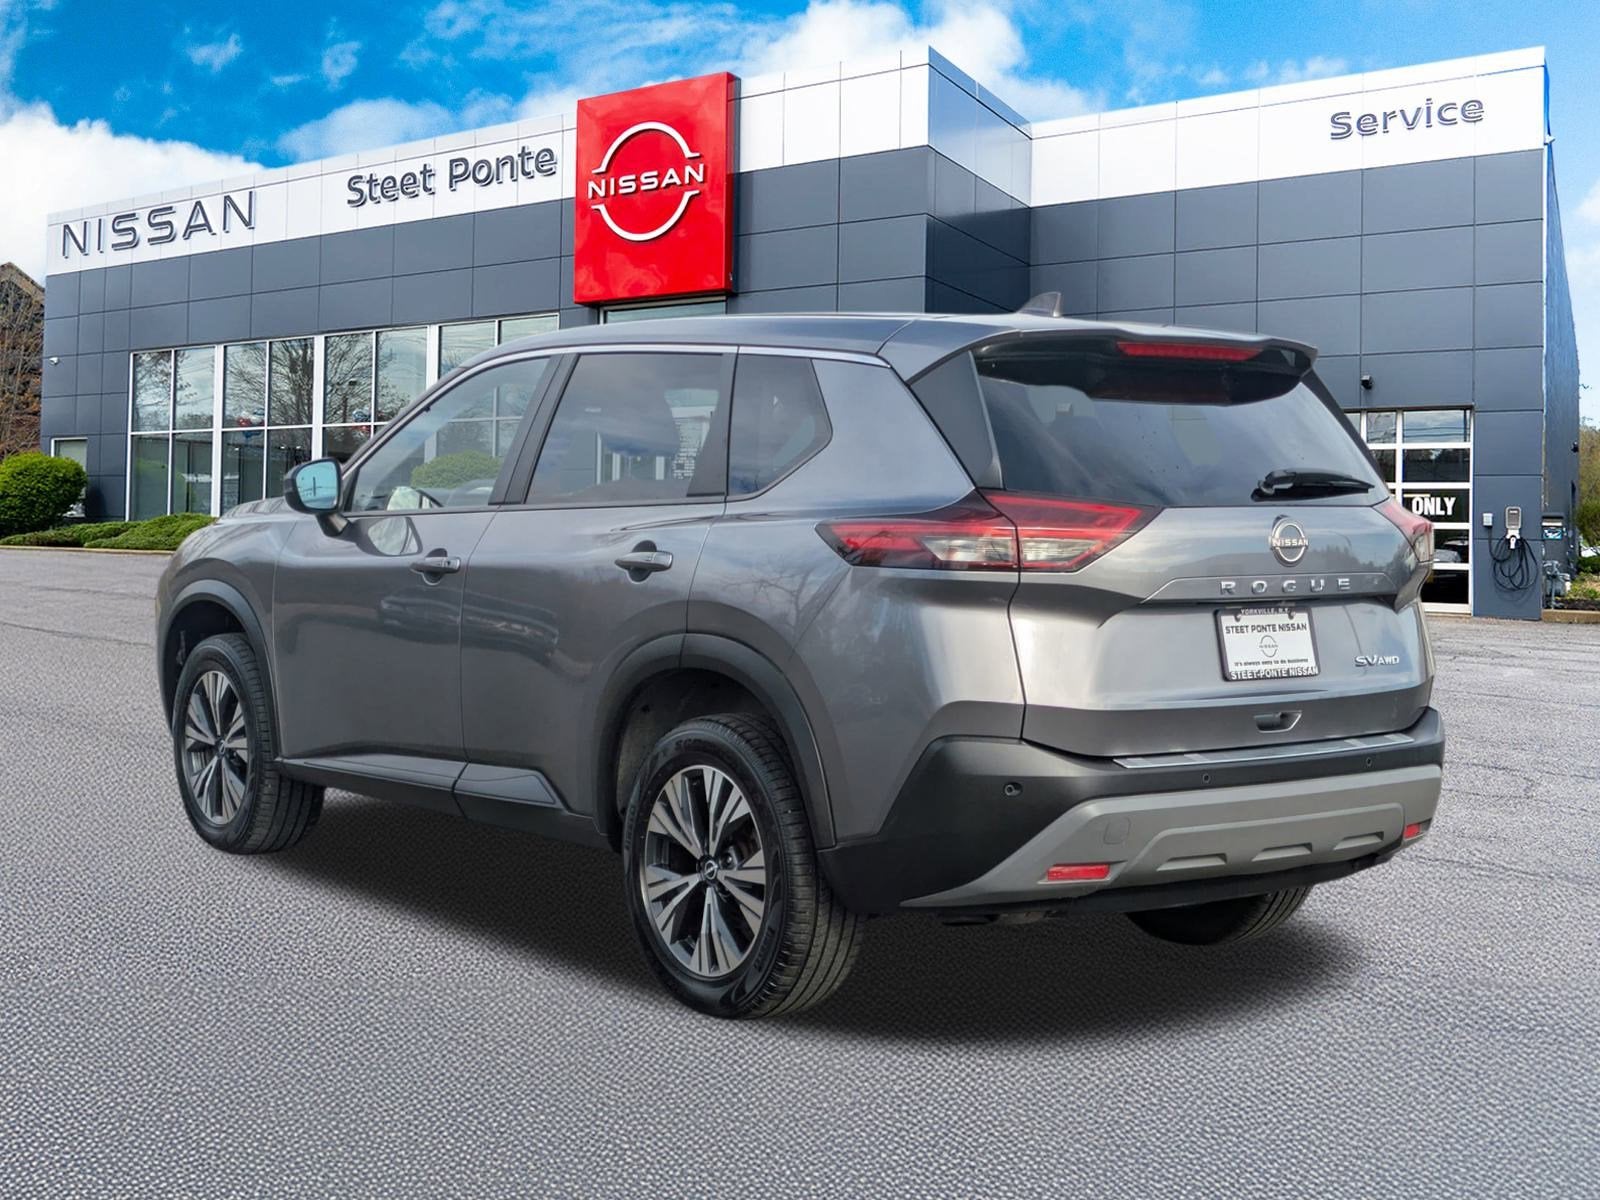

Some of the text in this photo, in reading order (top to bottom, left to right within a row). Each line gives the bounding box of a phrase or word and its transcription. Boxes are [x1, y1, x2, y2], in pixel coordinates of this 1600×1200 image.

[1330, 97, 1484, 140] Service
[347, 146, 557, 207] Steet Ponte
[587, 163, 704, 199] NISSAN
[62, 190, 255, 259] NISSAN
[1411, 496, 1456, 516] ONLY
[1270, 538, 1308, 547] NISSAN
[1220, 578, 1350, 595] ROGUE
[1225, 623, 1307, 634] STEET PONTE NISSAN
[1354, 655, 1400, 667] SV AWD
[1288, 666, 1319, 676] NISSAN
